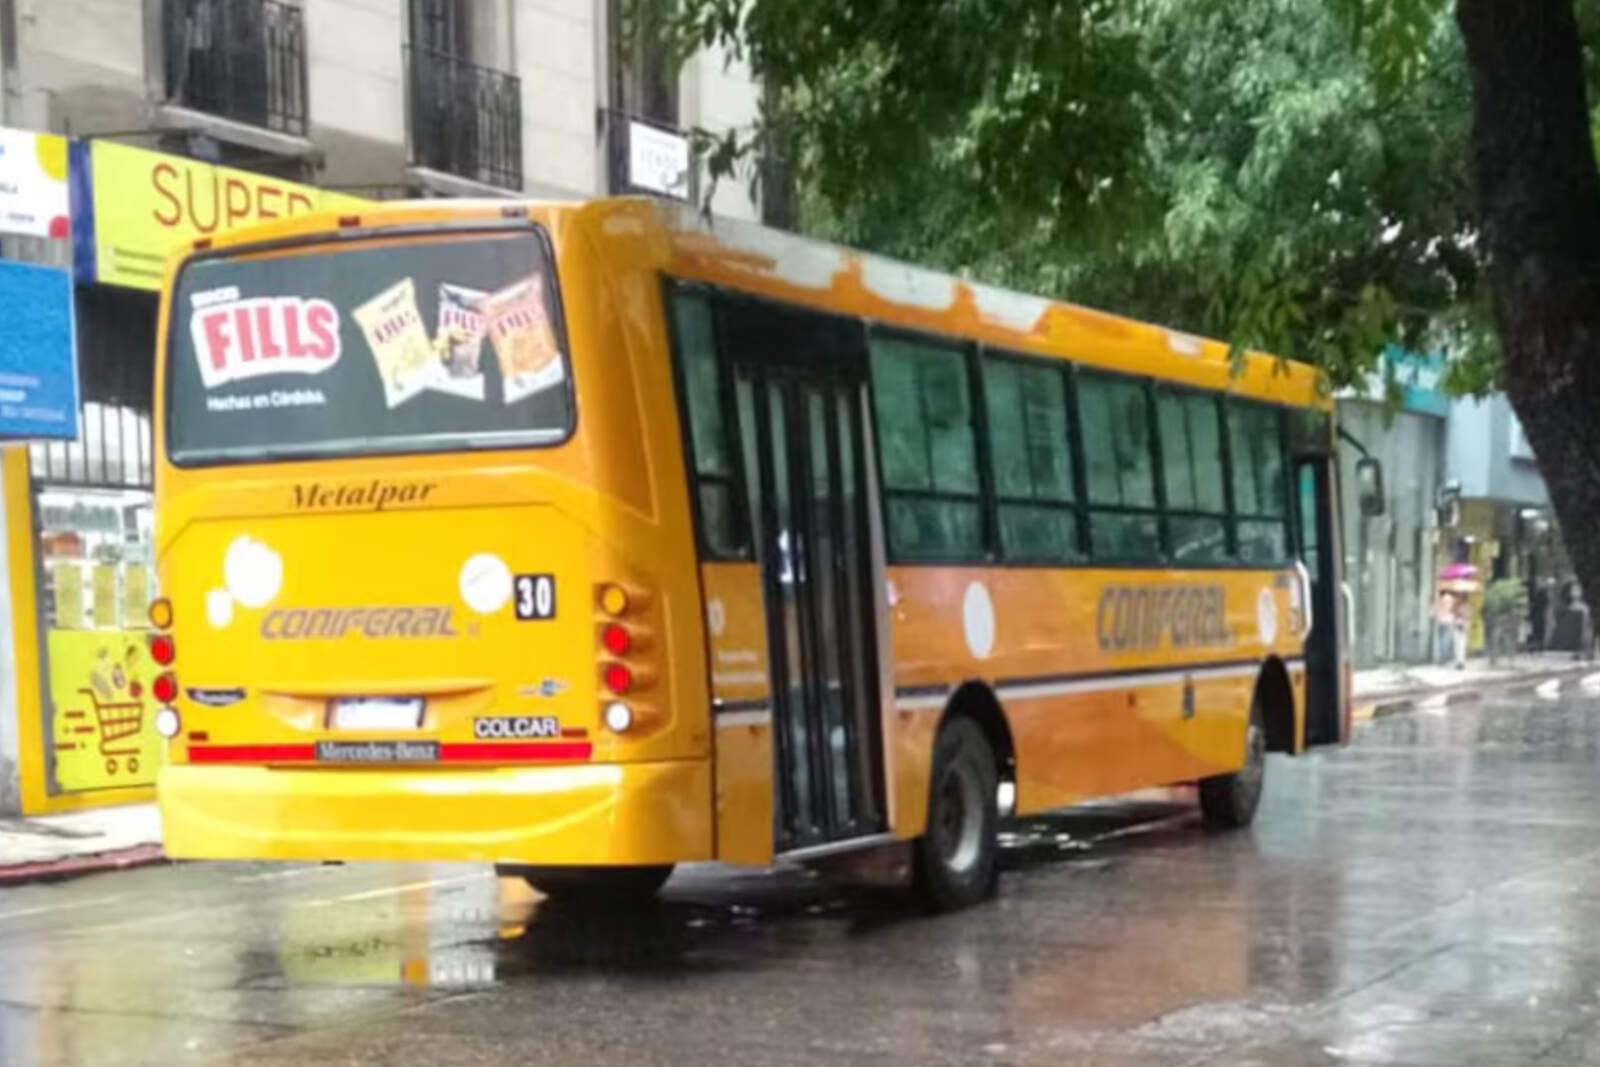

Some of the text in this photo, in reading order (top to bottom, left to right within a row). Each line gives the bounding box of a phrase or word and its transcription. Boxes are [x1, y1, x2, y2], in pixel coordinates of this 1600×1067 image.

[203, 305, 335, 370] FILLS
[294, 479, 438, 511] Metalpar
[518, 576, 551, 616] 30
[260, 606, 459, 641] CONIFERAL
[475, 718, 558, 738] COLCAR
[318, 741, 437, 761] Mercedes-Benz
